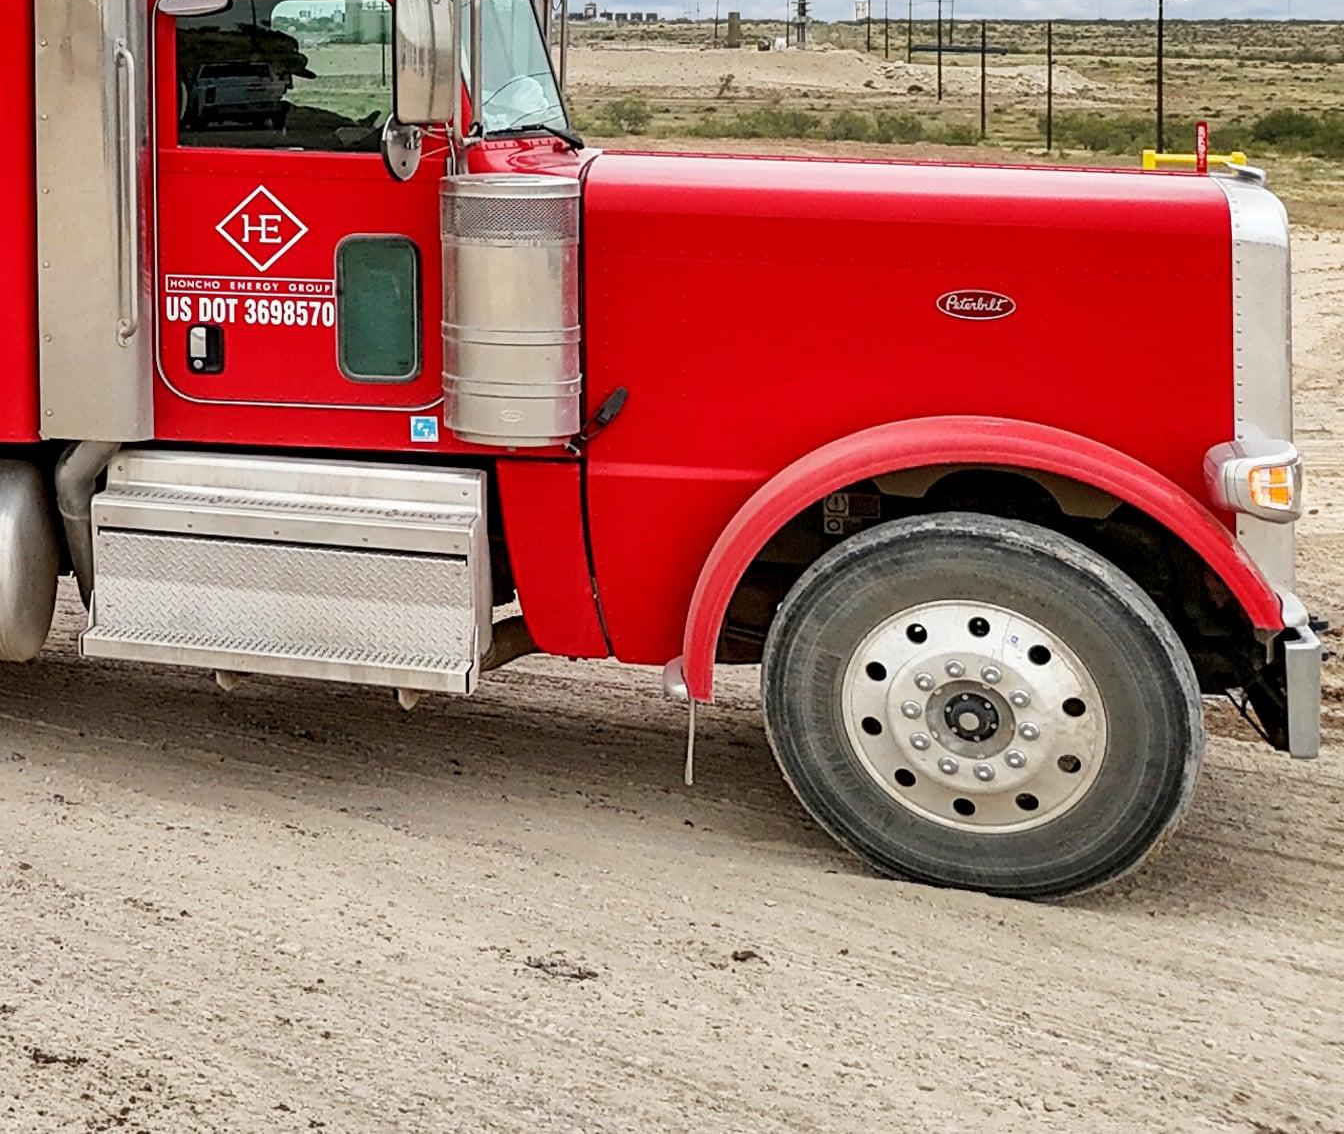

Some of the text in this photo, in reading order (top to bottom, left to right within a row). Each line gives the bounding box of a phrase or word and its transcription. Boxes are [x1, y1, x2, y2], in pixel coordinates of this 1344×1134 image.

[241, 214, 282, 243] HE
[170, 279, 331, 293] HONCHO ENERGY GROUP
[166, 296, 335, 327] US DOT 3698570
[946, 294, 1008, 311] Peterbilt
